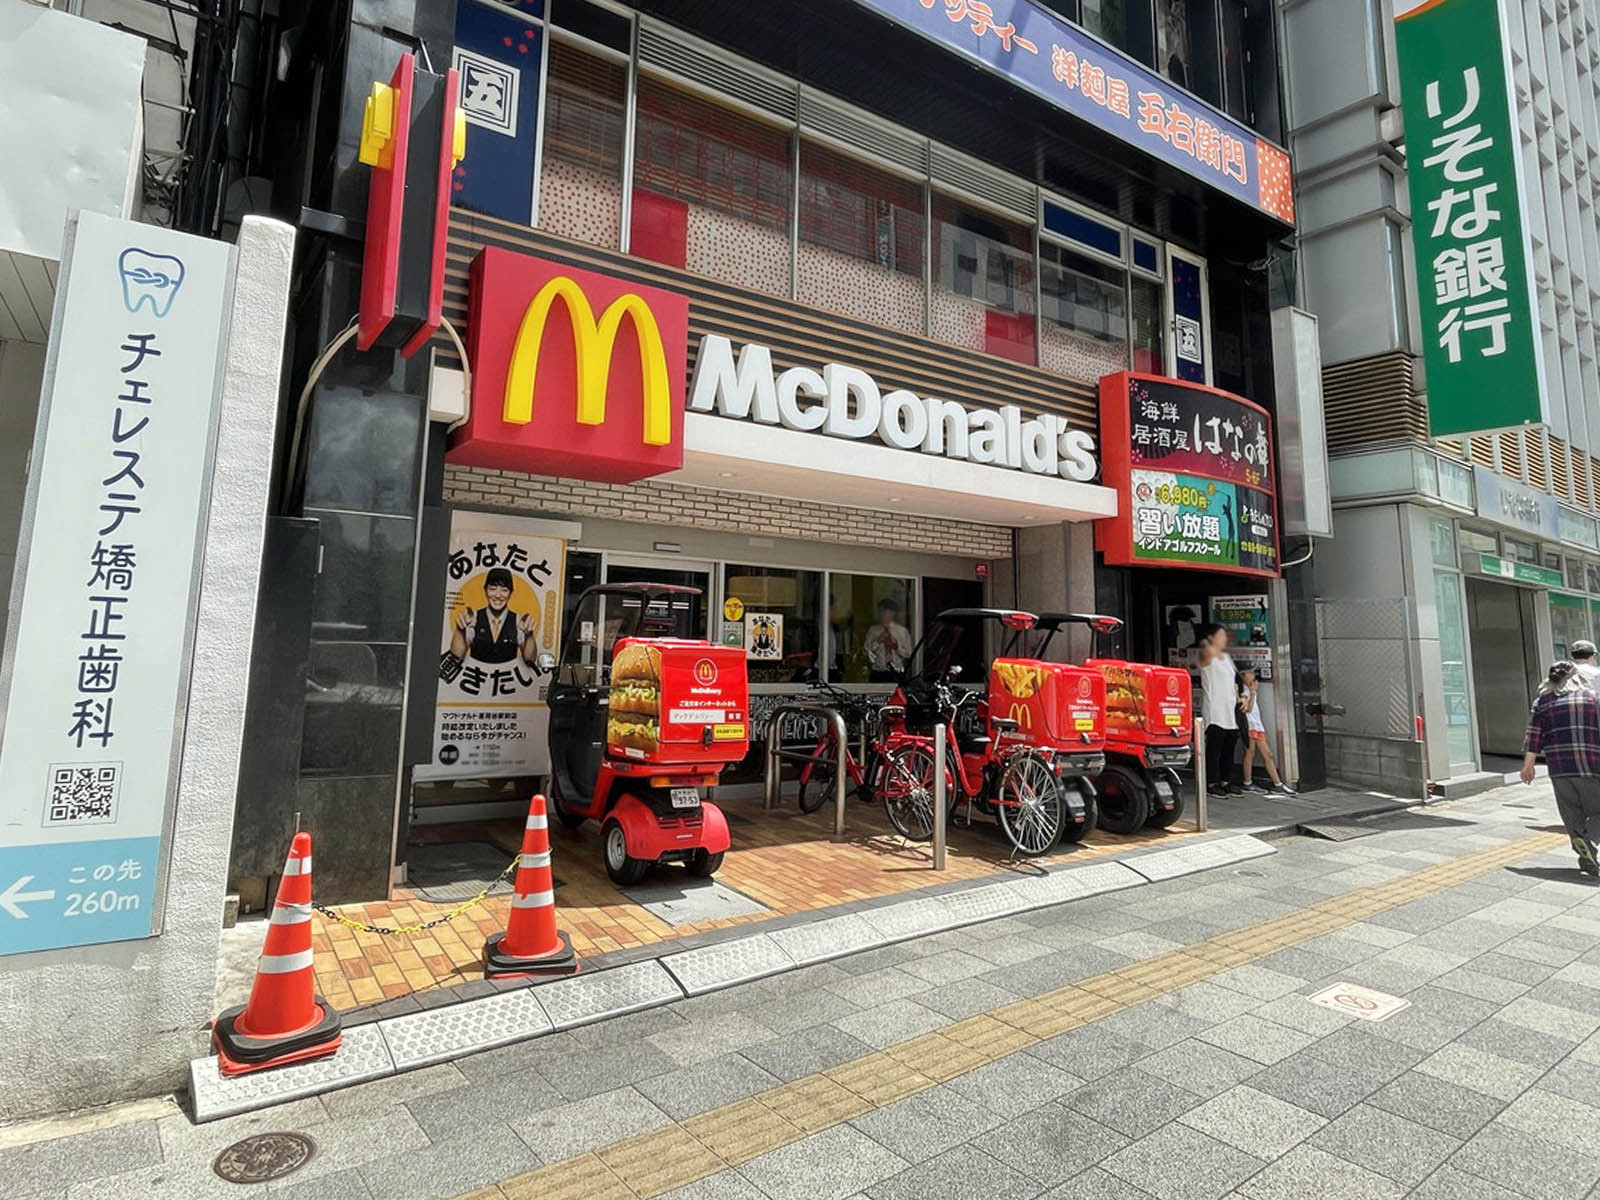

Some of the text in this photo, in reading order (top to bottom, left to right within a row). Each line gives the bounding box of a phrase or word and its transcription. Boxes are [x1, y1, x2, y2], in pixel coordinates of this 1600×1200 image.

[1138, 91, 1248, 185] 五右衛門
[1423, 66, 1512, 364] りそな銀行
[687, 334, 1098, 483] McDonald's
[1140, 401, 1181, 423] 海鮮
[1131, 424, 1191, 452] 居酒屋
[67, 334, 161, 748] チェレステ矯正歯科
[1138, 508, 1221, 542] 習い放題
[1138, 537, 1221, 556] インドアゴルフスクール
[449, 541, 552, 587] あなたと
[68, 859, 142, 884] この先
[63, 890, 140, 917] 260m
